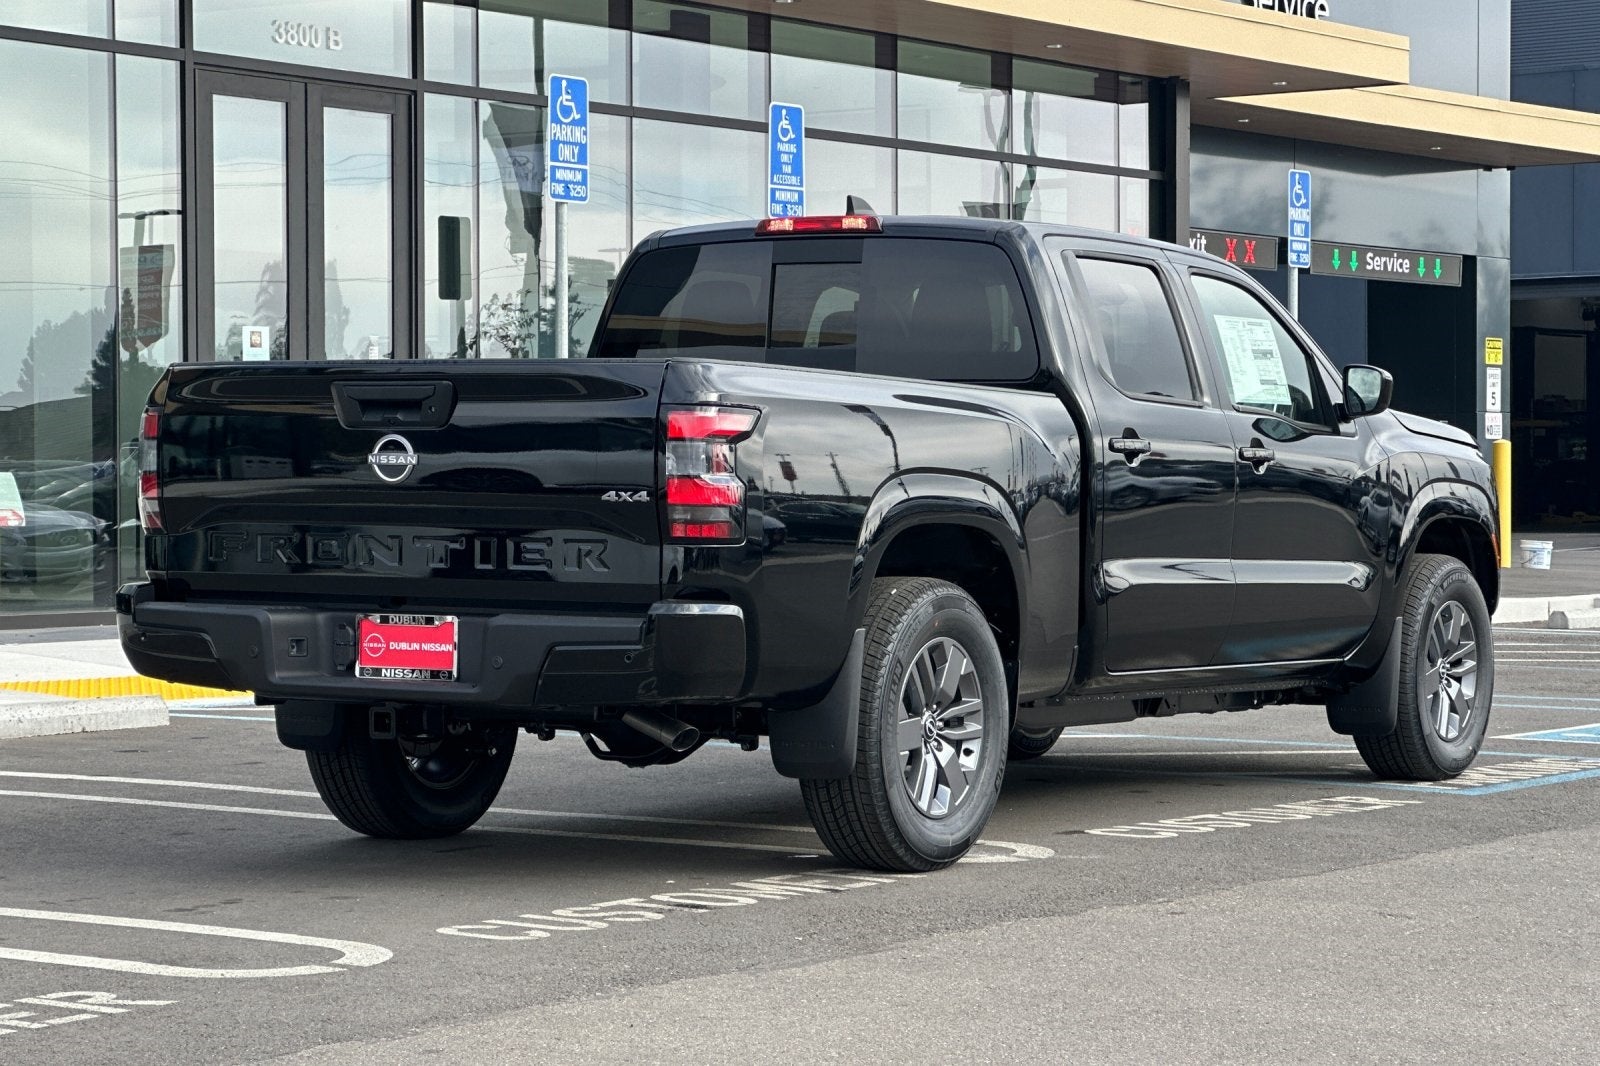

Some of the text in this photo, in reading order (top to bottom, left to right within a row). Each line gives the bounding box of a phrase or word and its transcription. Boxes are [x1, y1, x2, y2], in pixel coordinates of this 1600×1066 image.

[272, 20, 343, 50] 3800 B
[551, 123, 587, 145] PARKING
[558, 143, 579, 162] ONLY
[777, 142, 797, 153] PARKING
[780, 153, 794, 163] ONLY
[555, 168, 583, 182] MINIMUM
[782, 164, 792, 174] VAN
[773, 174, 801, 185] ACCESSIBLE
[551, 182, 586, 198] FINE $250
[775, 191, 799, 202] MINIMUM
[771, 202, 803, 216] FINE $250
[1293, 222, 1306, 236] ONLY
[1365, 252, 1410, 273] Service
[1490, 391, 1497, 406] 5
[368, 455, 416, 464] NISSAN
[206, 530, 613, 574] FRONTIER
[389, 615, 426, 625] DUBLIN
[389, 641, 420, 651] DUBLIN
[421, 643, 453, 652] NISSAN
[381, 669, 431, 679] NISSAN
[1084, 796, 1425, 839] CUSTOMER
